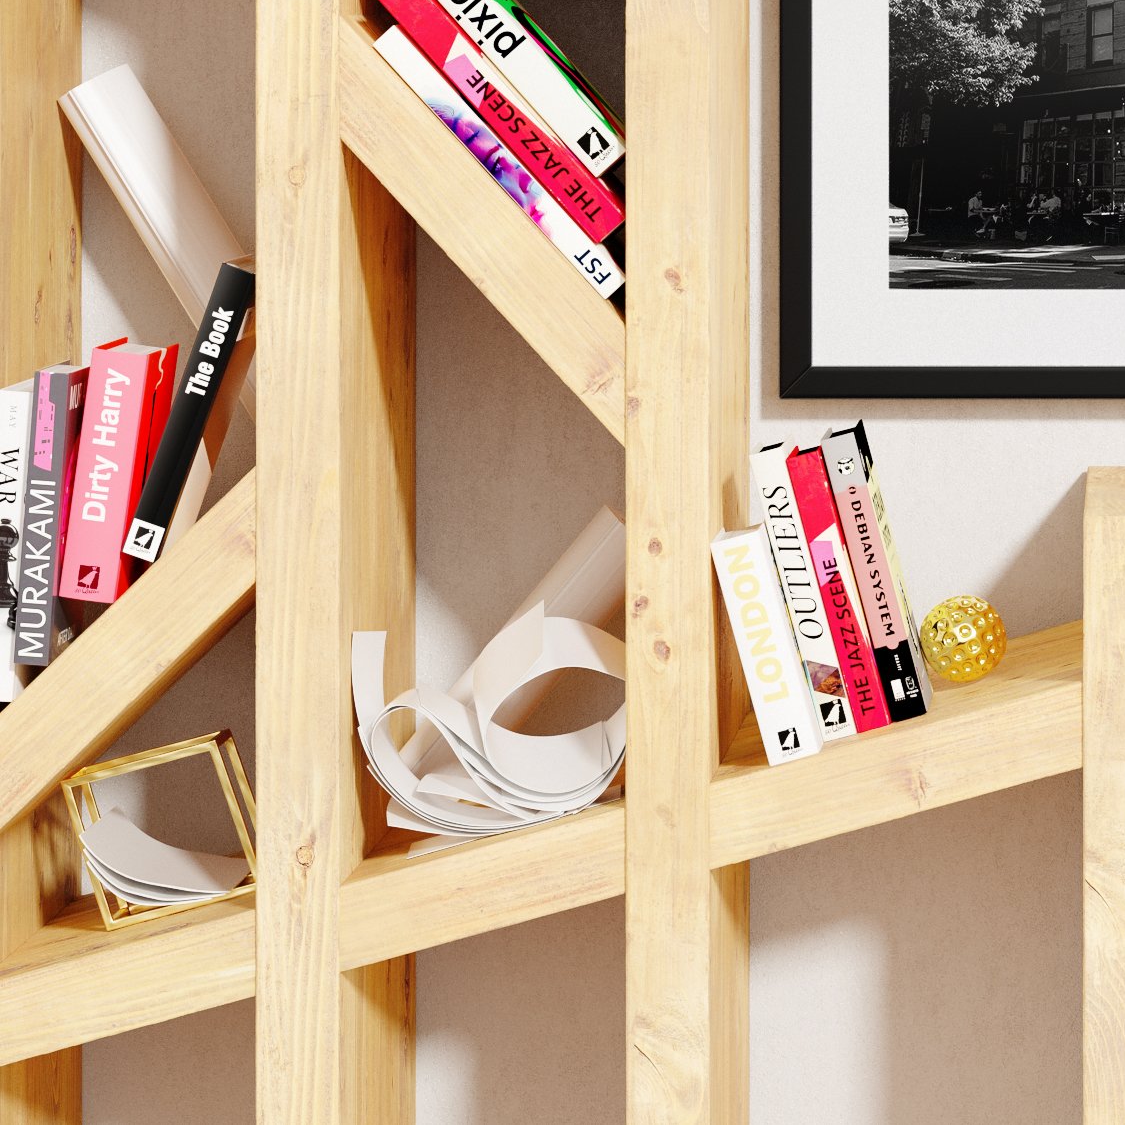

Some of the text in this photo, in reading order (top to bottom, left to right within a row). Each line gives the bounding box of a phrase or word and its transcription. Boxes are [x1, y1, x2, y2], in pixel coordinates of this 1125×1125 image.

[466, 70, 602, 223] THE JAZZ SCENE
[574, 249, 612, 285] FST
[184, 306, 235, 397] The Book
[0, 448, 20, 504] WAR
[82, 367, 131, 523] Dirty Harry
[17, 479, 57, 658] MURAKAMI
[724, 545, 790, 704] LONDON
[762, 485, 824, 640] OUTLIERS
[823, 557, 875, 716] THE JAZZ SCENE
[851, 500, 876, 565] DEBIAN
[870, 569, 895, 637] SYSTEM
